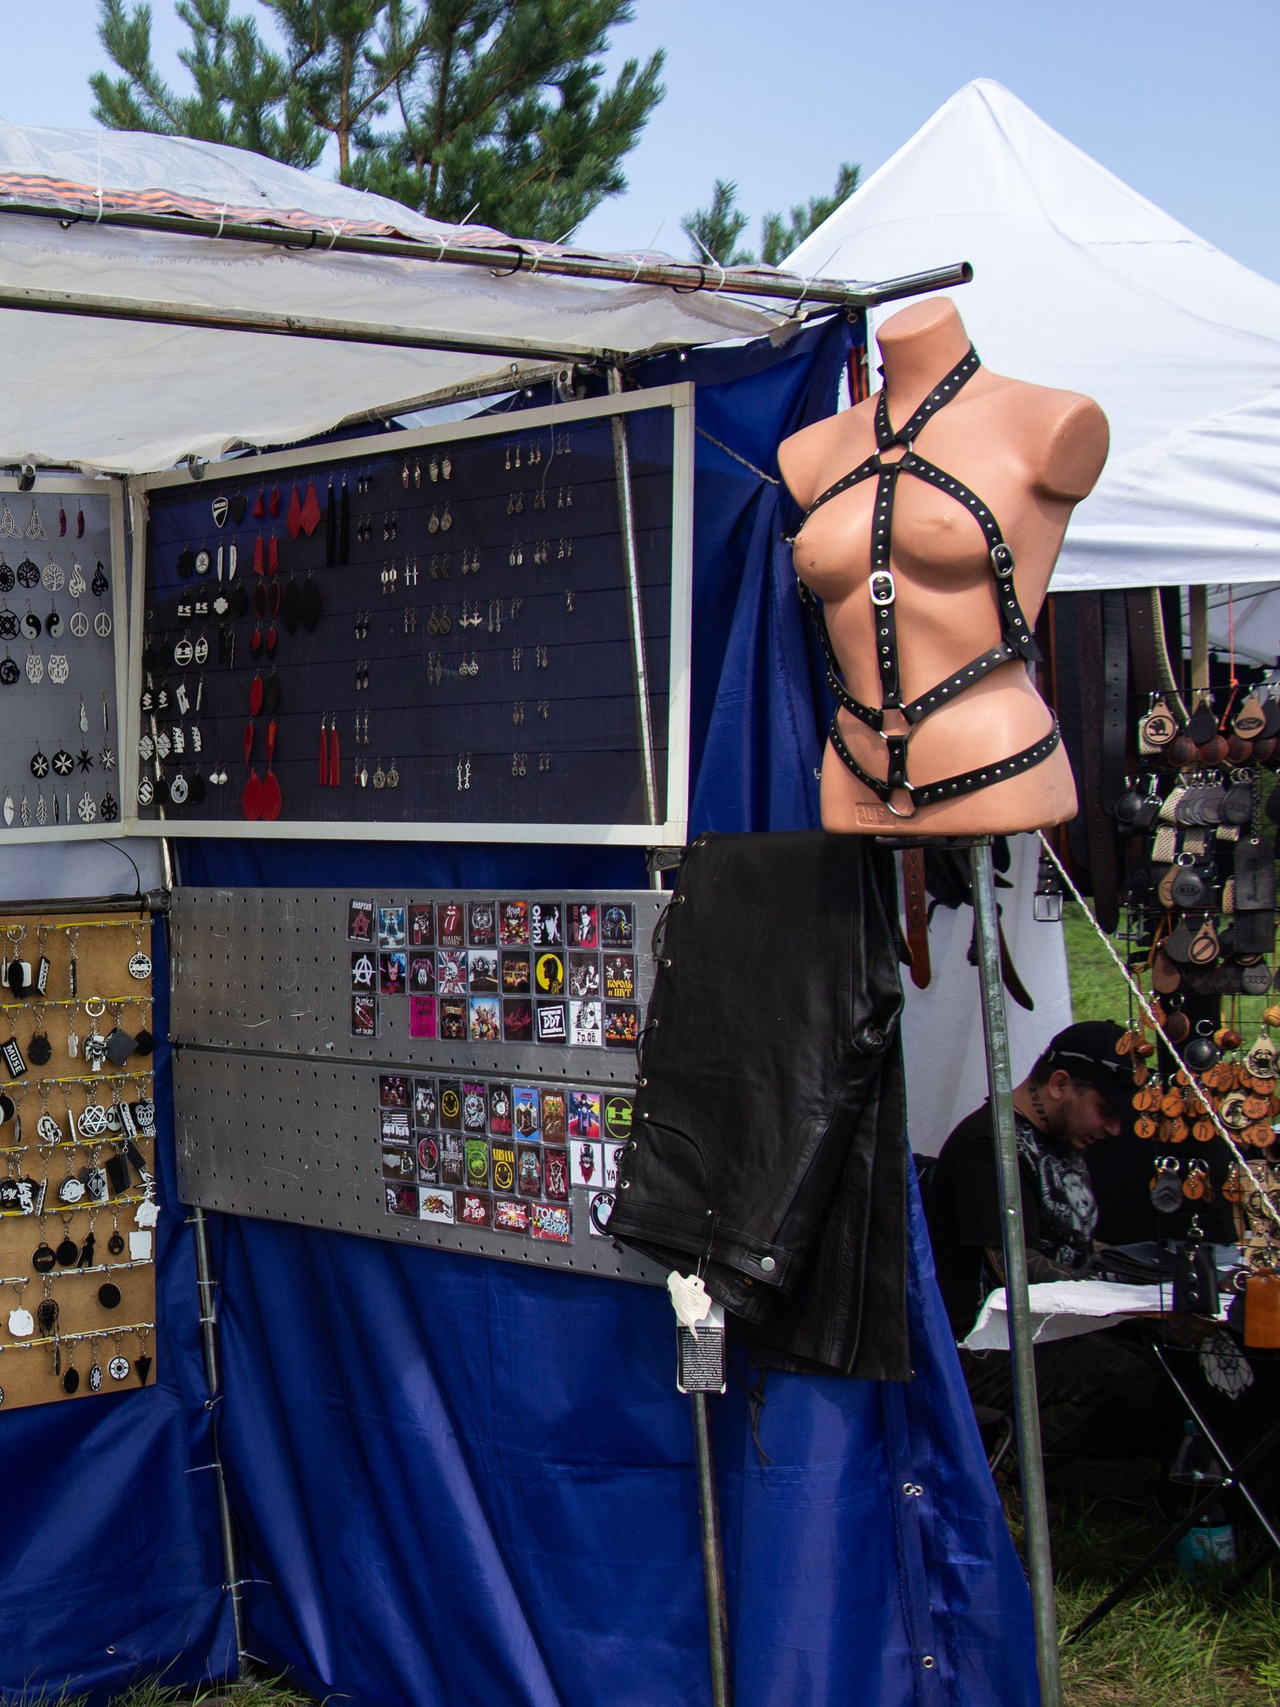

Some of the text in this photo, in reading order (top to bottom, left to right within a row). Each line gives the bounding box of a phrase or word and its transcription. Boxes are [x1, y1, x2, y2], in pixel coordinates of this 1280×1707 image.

[533, 905, 542, 943] КИНО
[607, 980, 633, 988] КОРОЛЬ
[614, 988, 631, 999] ШУТ
[6, 1044, 22, 1073] MUSE
[493, 1149, 514, 1162] NIRVANA
